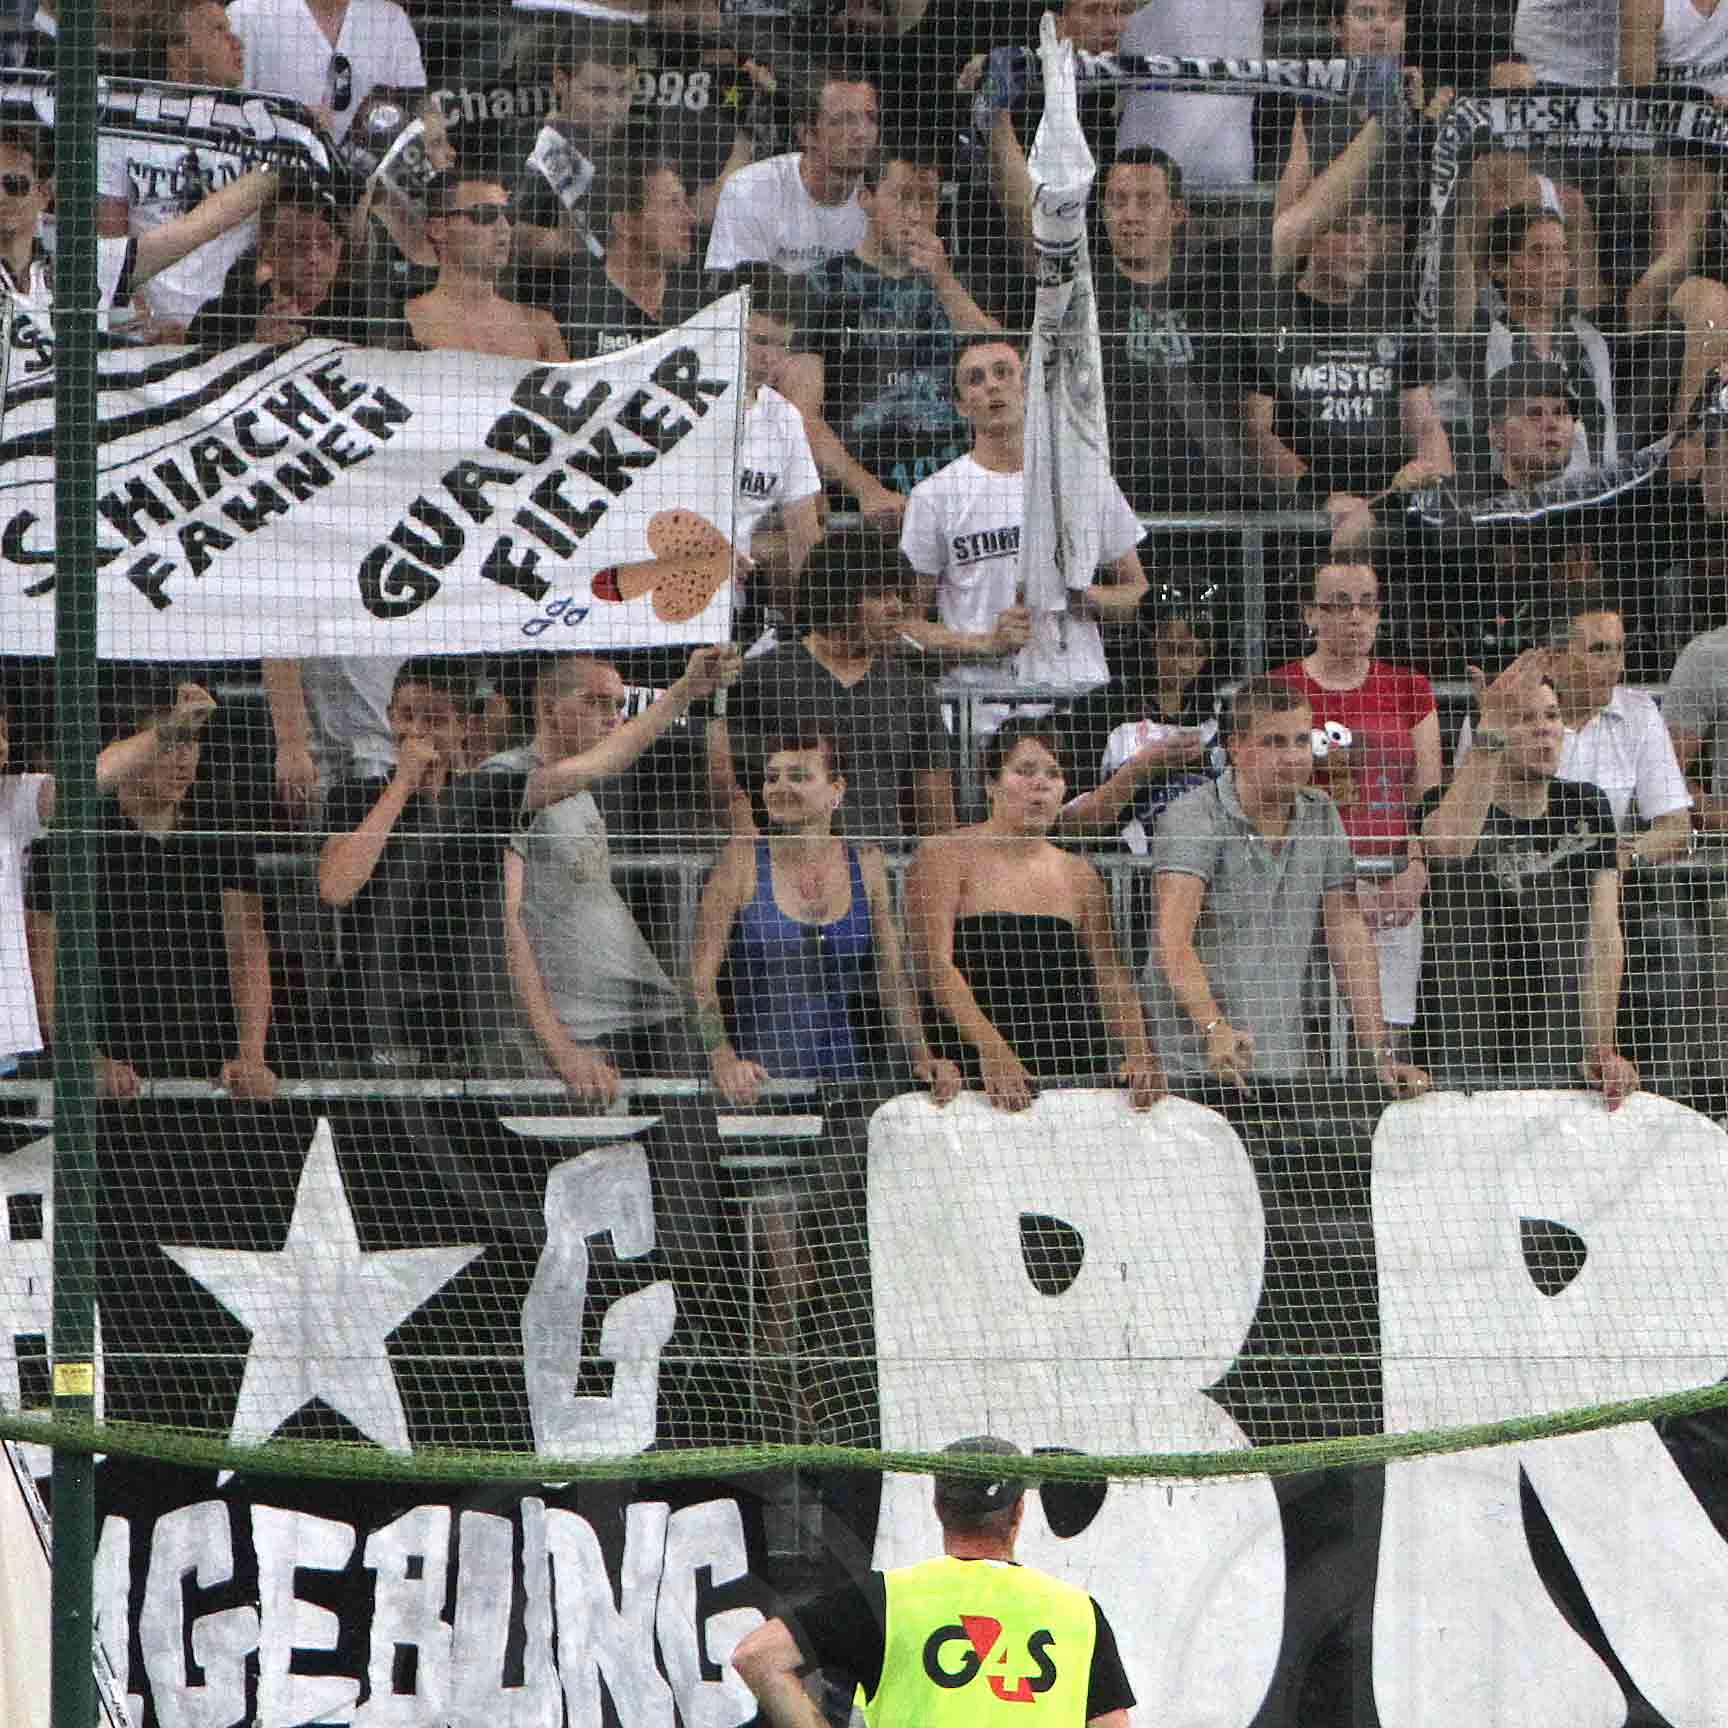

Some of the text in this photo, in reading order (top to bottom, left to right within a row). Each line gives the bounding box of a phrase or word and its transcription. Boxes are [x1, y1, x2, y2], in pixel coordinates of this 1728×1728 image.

[430, 68, 716, 117] Cham 998
[1150, 57, 1346, 94] STURM
[2, 357, 372, 598] SHIACHE
[481, 344, 731, 602] FICKER
[1320, 394, 1376, 424] 2011
[127, 384, 416, 610] FAHNEN
[357, 366, 612, 620] GUADE
[922, 1614, 1056, 1704] G4S
